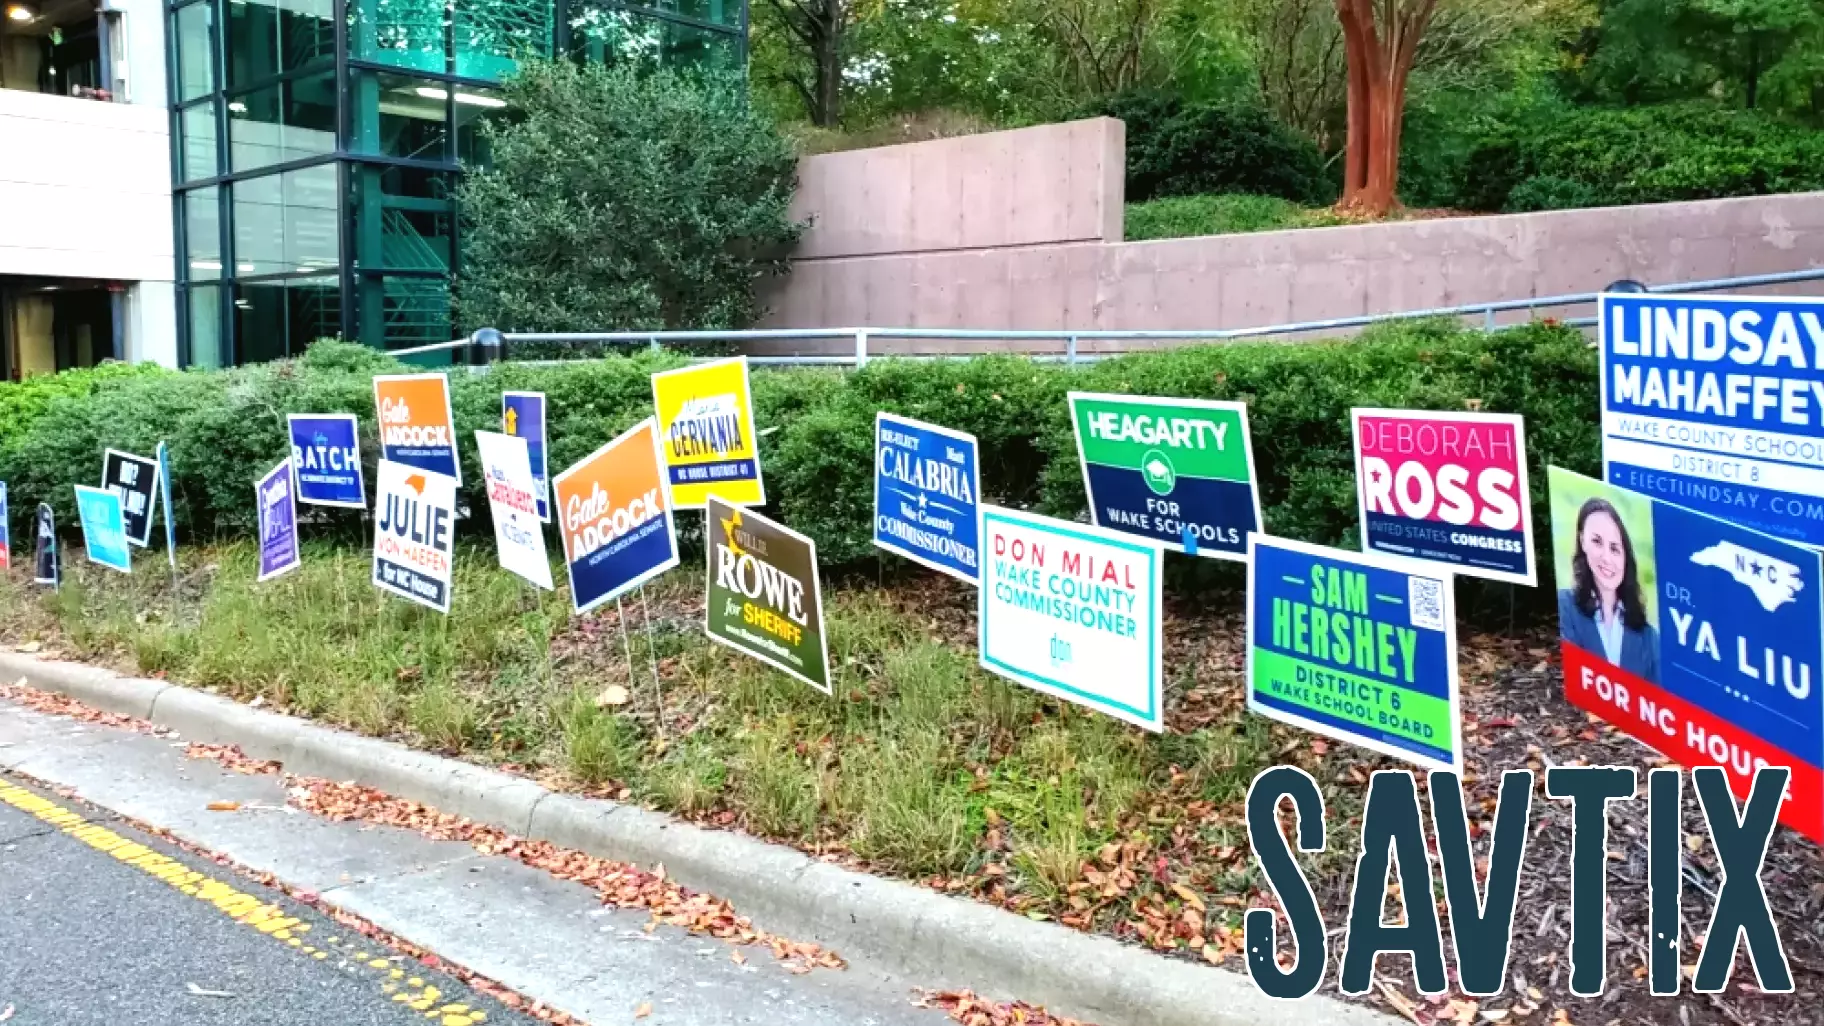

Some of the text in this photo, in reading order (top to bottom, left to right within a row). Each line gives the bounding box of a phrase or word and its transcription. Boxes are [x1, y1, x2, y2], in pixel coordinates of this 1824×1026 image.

[1612, 305, 1824, 370] LINDSAY
[1613, 363, 1824, 428] MAHAFFEY
[384, 425, 452, 447] ADCOCK
[671, 412, 744, 458] CERVANIA
[1087, 411, 1229, 451] HEAGARTY
[1360, 421, 1513, 461] DEBORAH
[1618, 418, 1659, 439] WAKE
[1666, 425, 1736, 449] COUNTY
[292, 445, 360, 471] BATCH
[880, 446, 974, 506] CALABRIA
[1672, 454, 1760, 483] DISTRICT 8
[566, 481, 609, 532] Gale
[1146, 498, 1181, 517] FOR
[1362, 456, 1520, 531] ROSS
[1630, 471, 1824, 522] ELECTLINDSAY.COM
[379, 491, 449, 552] JULIE
[379, 537, 400, 556] VON
[573, 488, 662, 561] ADCOCK
[878, 515, 977, 568] COMMISSIONER
[918, 511, 955, 534] County
[1106, 507, 1240, 544] WAKE SCHOOLS
[1405, 526, 1448, 543] STATES
[1450, 532, 1523, 554] CONGRESS
[396, 568, 410, 588] NC
[716, 543, 808, 627] ROWE
[994, 534, 1136, 590] DON MIAL
[995, 559, 1136, 613] WAKE COUNTY
[995, 581, 1137, 641] COMMISSIONER
[1311, 563, 1369, 615] SAM
[1665, 582, 1697, 608] DR.
[724, 598, 803, 647] for SHERIFF
[1272, 597, 1417, 683] HERSHEY
[1668, 607, 1812, 700] YA LIU
[1271, 678, 1434, 738] WAKE SCHOOL BOARD
[1295, 665, 1402, 710] DISTRICT 6
[1580, 665, 1793, 801] FOR NC HOU
